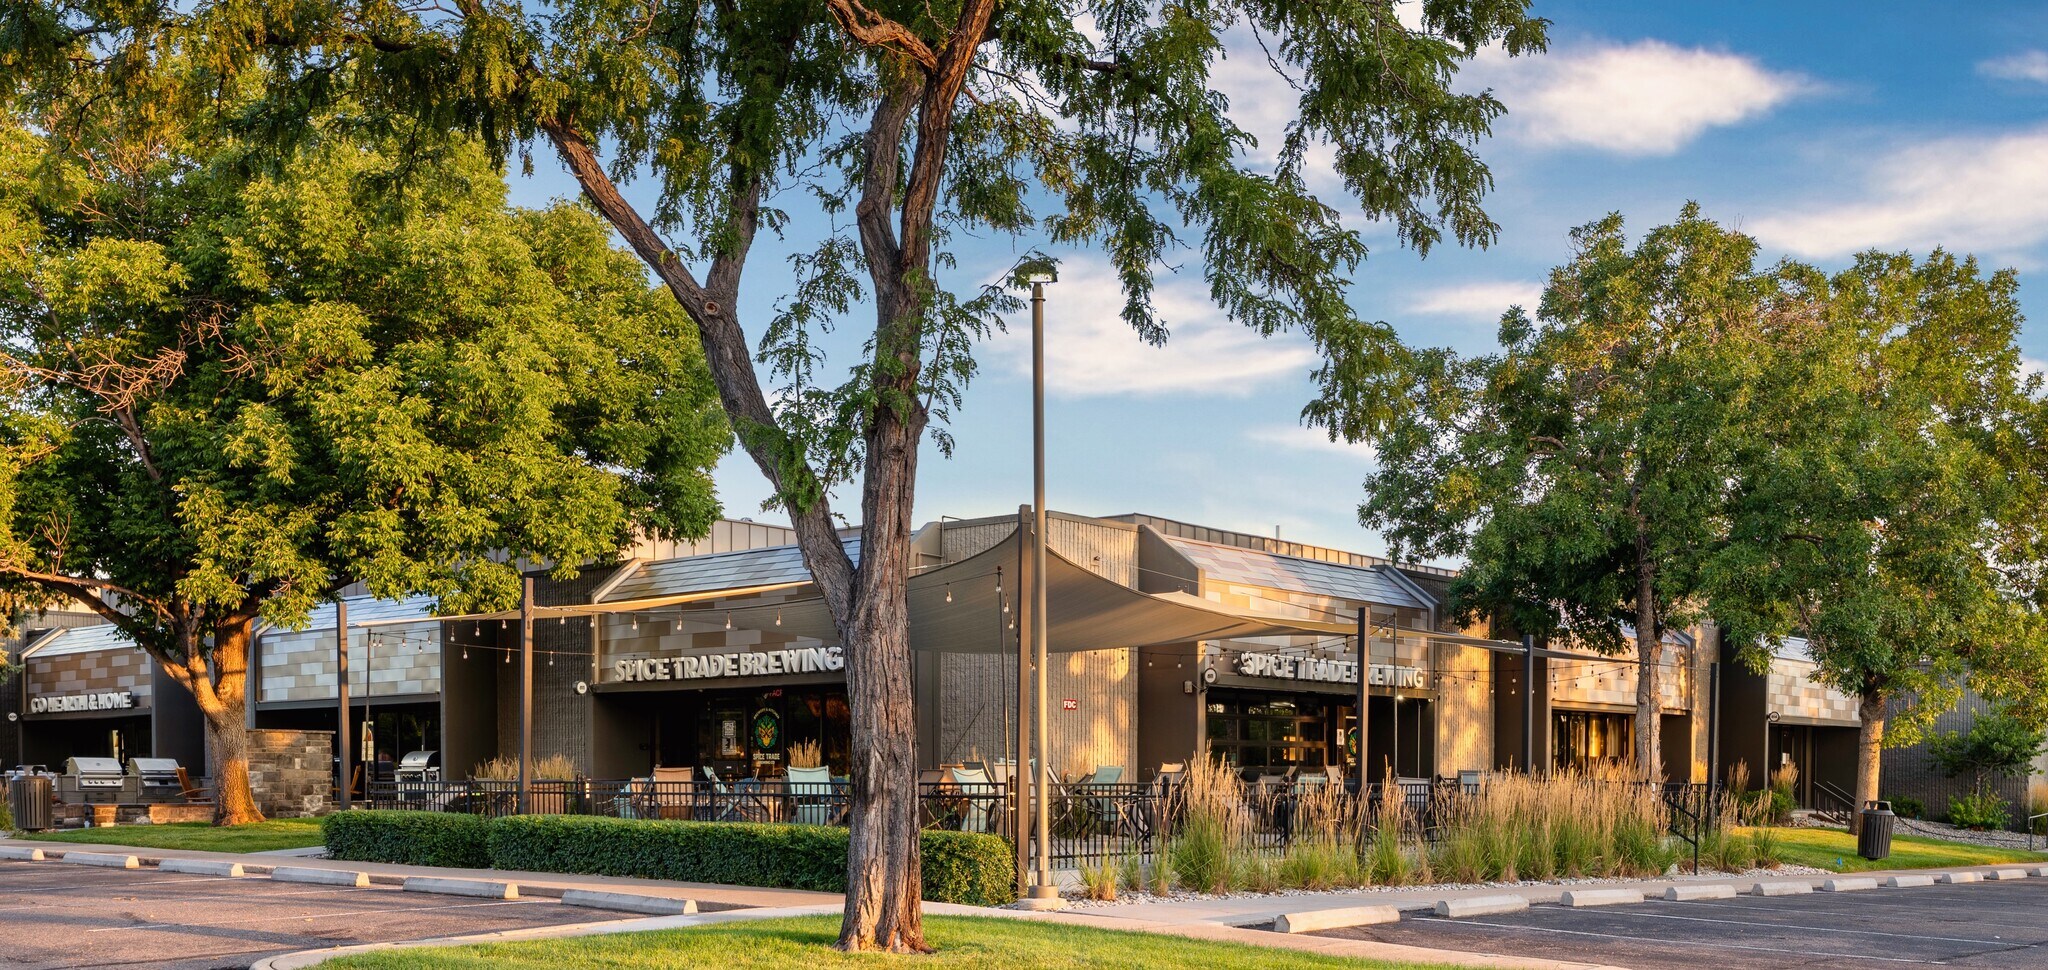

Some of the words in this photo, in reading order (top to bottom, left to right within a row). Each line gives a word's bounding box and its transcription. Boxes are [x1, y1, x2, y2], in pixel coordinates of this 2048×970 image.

[614, 657, 670, 682] SPICE
[670, 653, 740, 679] TRADE
[739, 646, 845, 675] BREWING
[1240, 651, 1294, 678] SPICE
[1295, 656, 1352, 683] TRADE
[31, 697, 48, 713] CO
[88, 693, 99, 710] &
[98, 691, 132, 709] HOME
[1063, 700, 1076, 709] FDC
